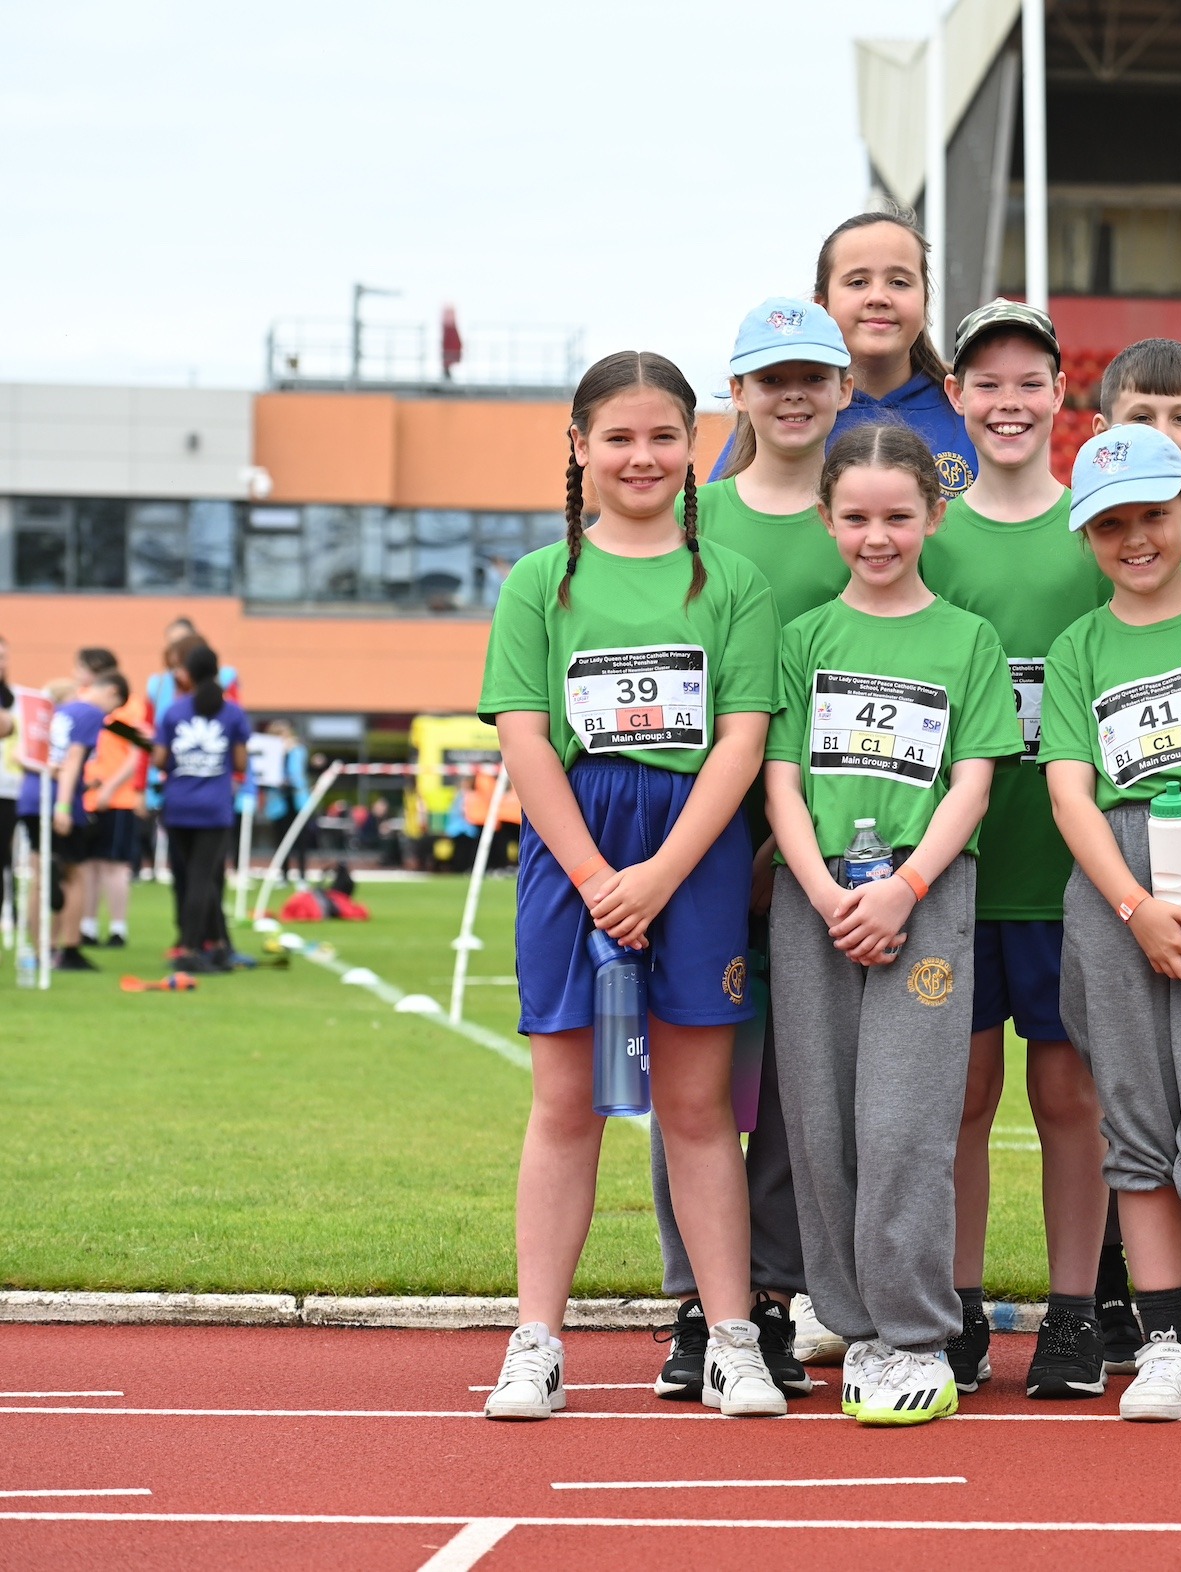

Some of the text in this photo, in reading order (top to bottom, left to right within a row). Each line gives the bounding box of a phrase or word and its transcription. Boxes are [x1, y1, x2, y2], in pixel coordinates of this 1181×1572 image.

[616, 677, 658, 704] 39
[860, 684, 904, 694] School, Penshaw
[877, 680, 893, 688] Peace
[894, 682, 916, 690] Catholic
[917, 686, 938, 696] Primary
[1130, 685, 1173, 699] School, Penshaw
[1109, 694, 1120, 702] Lady
[1121, 689, 1138, 697] Queen
[629, 713, 652, 728] C1
[674, 712, 693, 726] A1
[855, 702, 898, 730] 42
[1138, 700, 1178, 729] 41
[584, 717, 606, 732] B1
[923, 718, 941, 730] SSP
[612, 732, 672, 742] Main Group: 3
[823, 736, 839, 750] B1
[1153, 735, 1175, 750] C1
[861, 738, 881, 753] C1
[1026, 744, 1030, 752] 3
[904, 746, 924, 762] A1
[1115, 750, 1133, 768] B1
[842, 756, 898, 769] Main Group: 3
[1138, 758, 1160, 770] Main
[921, 957, 946, 966] QUEEN
[627, 1036, 644, 1056] air
[765, 1310, 783, 1320] adidas
